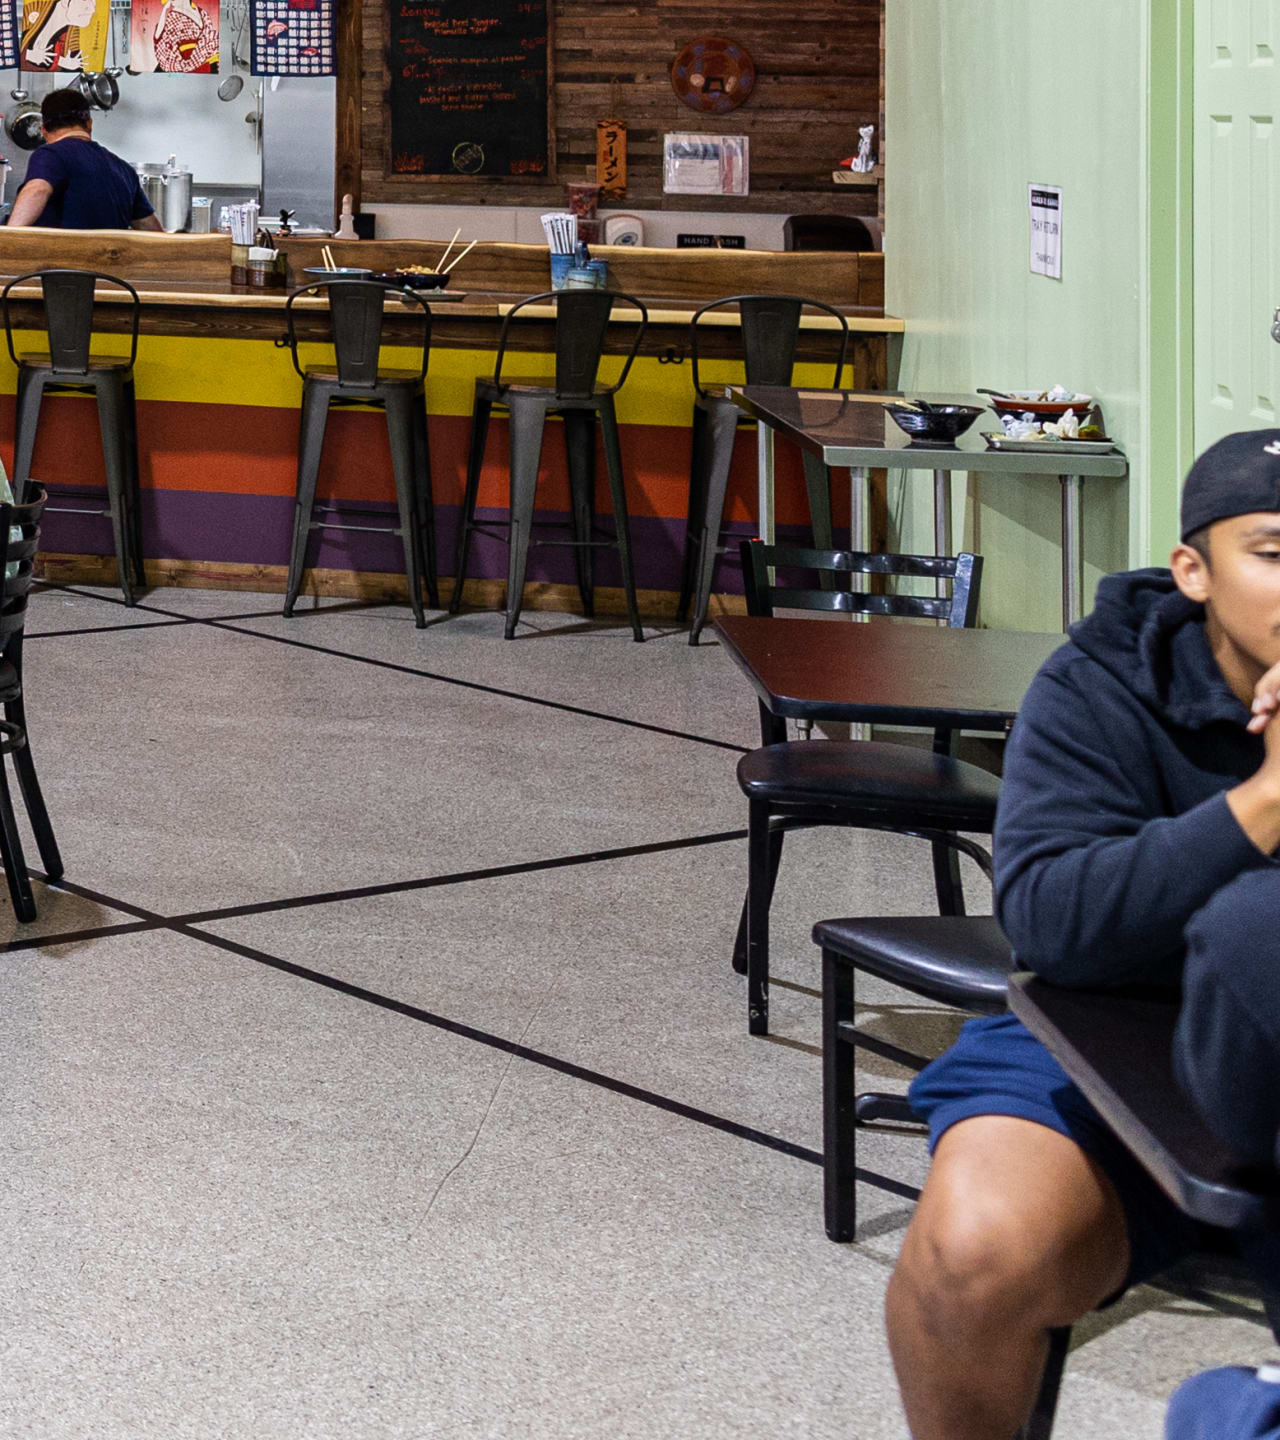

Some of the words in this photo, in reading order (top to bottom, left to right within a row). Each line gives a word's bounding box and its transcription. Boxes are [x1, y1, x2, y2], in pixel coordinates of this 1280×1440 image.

[605, 131, 619, 183] ラーメン
[684, 237, 709, 245] HAND
